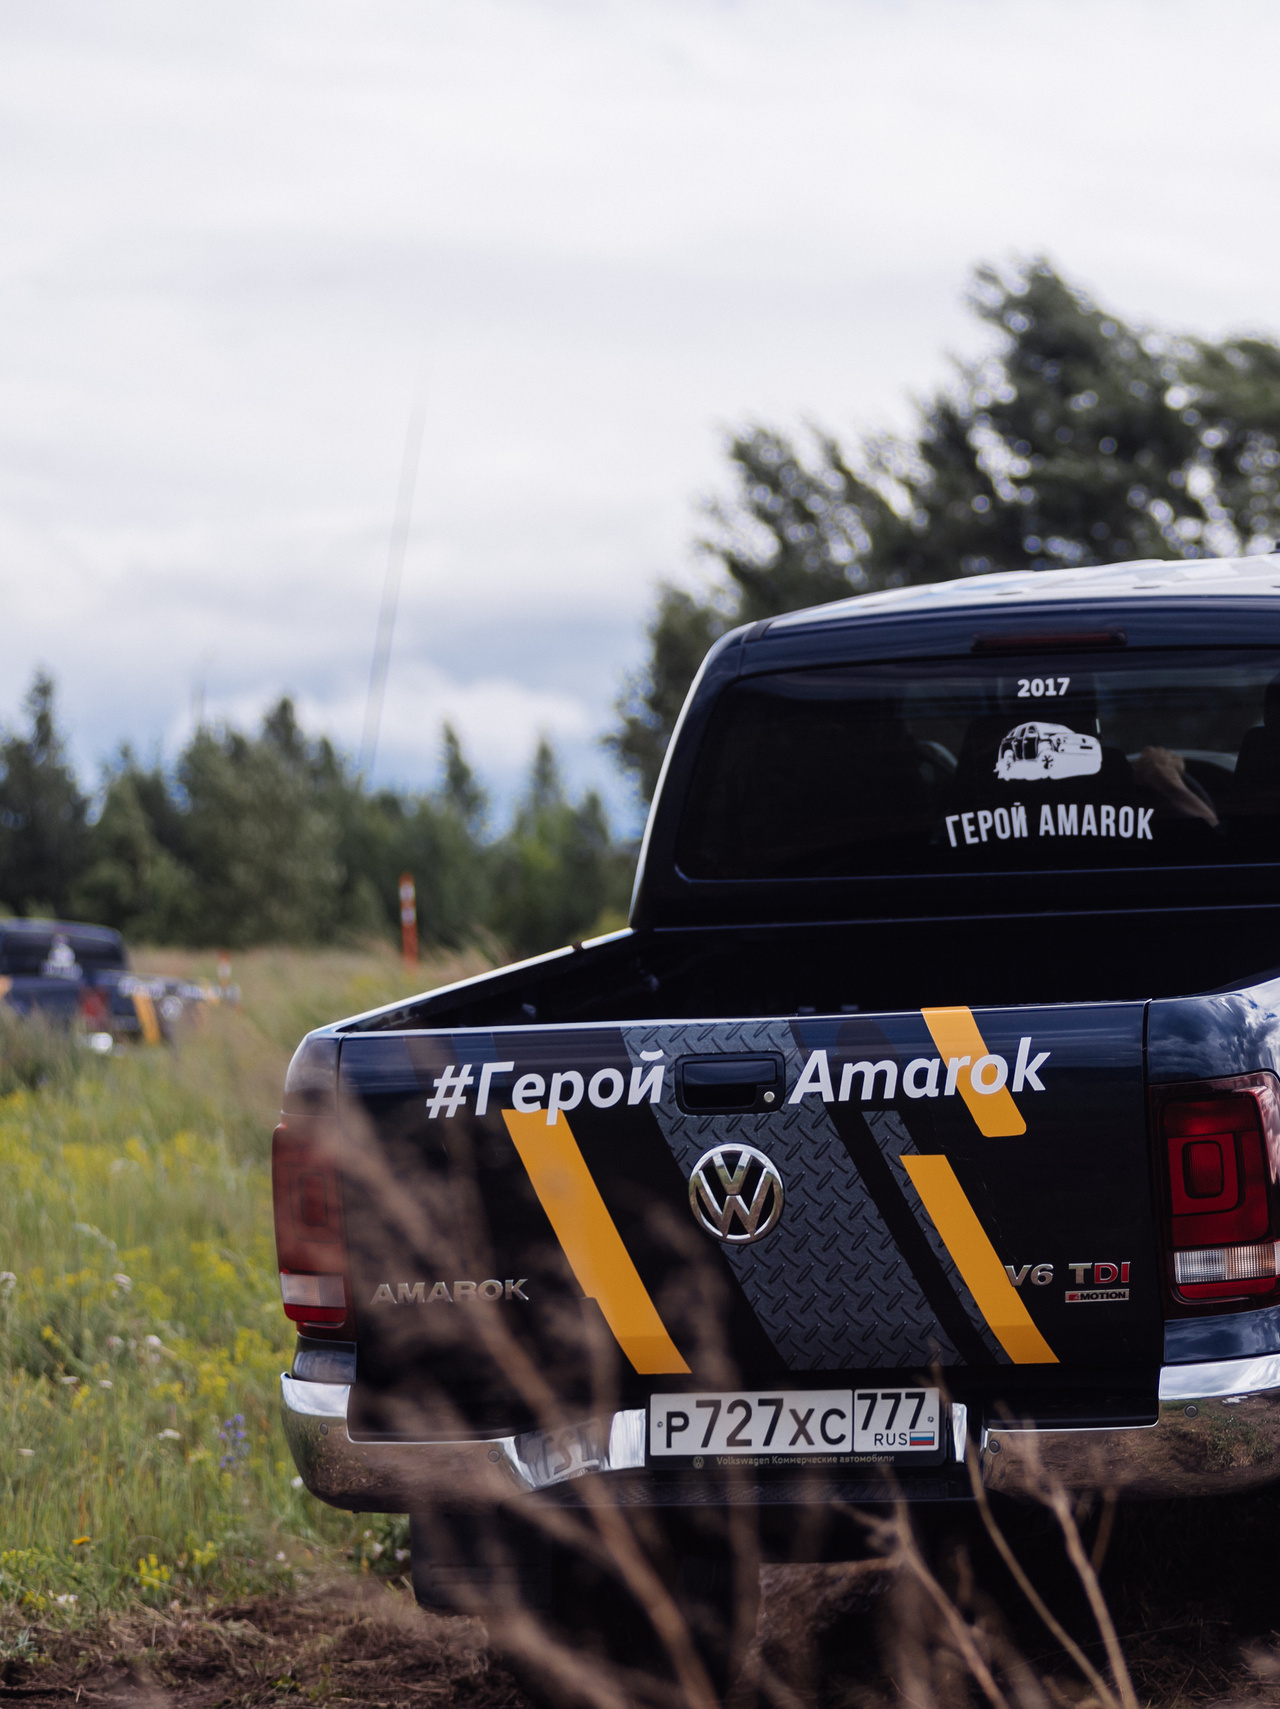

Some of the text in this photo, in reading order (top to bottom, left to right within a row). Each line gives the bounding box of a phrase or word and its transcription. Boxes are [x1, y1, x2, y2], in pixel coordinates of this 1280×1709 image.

[1017, 677, 1071, 698] 2017
[945, 802, 1155, 847] ГЕРОЙ AMAROK
[426, 1036, 1051, 1126] #Герой Amarok
[1004, 1261, 1131, 1287] V6 TDI
[370, 1278, 529, 1304] AMAROK
[857, 1391, 926, 1431] 777
[874, 1432, 908, 1447] RUS
[716, 1453, 895, 1467] Volkswagen Коммерческие автомобили
